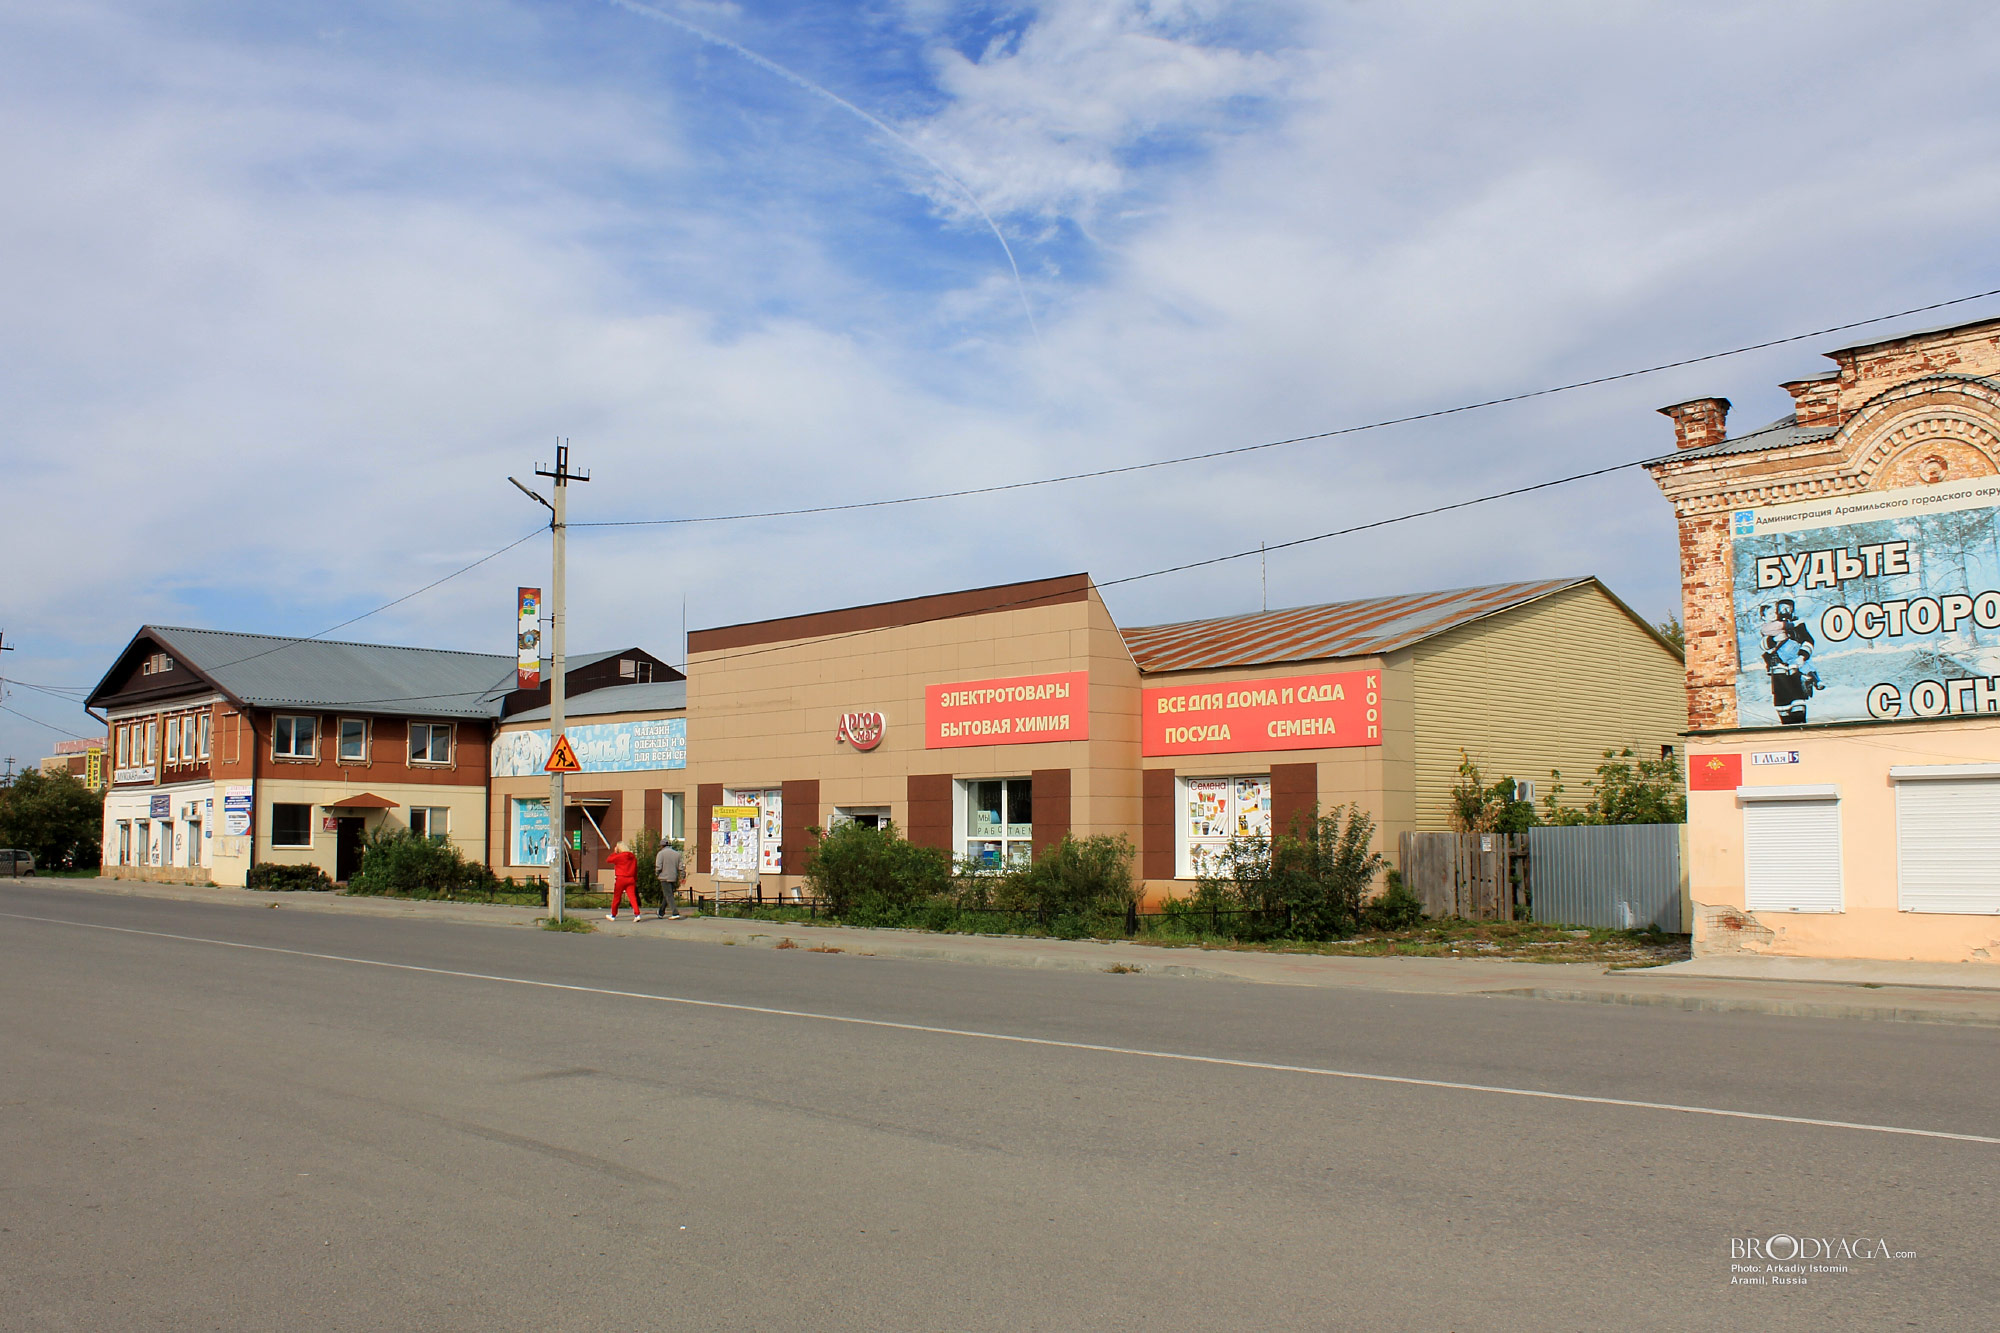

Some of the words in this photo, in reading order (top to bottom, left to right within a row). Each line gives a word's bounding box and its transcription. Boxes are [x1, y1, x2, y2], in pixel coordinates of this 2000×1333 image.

[1755, 507, 1832, 526] Администрация
[1835, 497, 1908, 517] Арамильского
[1911, 490, 1972, 506] городского
[1756, 540, 1910, 590] БУДЬТЕ
[1821, 589, 2000, 643] ОСТОРО
[940, 683, 1070, 708] ЭЛЕКТРОТОВАРЫ
[1158, 695, 1186, 714] ВСЕ
[1187, 693, 1224, 713] ДЛЯ
[1225, 689, 1279, 710] ДОМА
[1282, 688, 1294, 705] И
[1298, 683, 1345, 704] САДА
[1366, 675, 1378, 739] КООП
[634, 725, 670, 737] МАГАЗИН
[940, 718, 1011, 738] БЫТОВАЯ
[1014, 714, 1070, 734] ХИМИЯ
[1165, 723, 1232, 744] ПОСУДА
[1268, 717, 1336, 738] СЕМЕНА
[634, 738, 669, 750] ОДЕЖДЫ
[671, 737, 677, 747] И
[634, 752, 650, 762] ДЛЯ
[652, 748, 672, 761] ВСЕЙ
[1762, 753, 1786, 764] Мая
[1789, 751, 1799, 763] 15
[1190, 780, 1226, 791] Семена
[978, 814, 991, 822] МЫ
